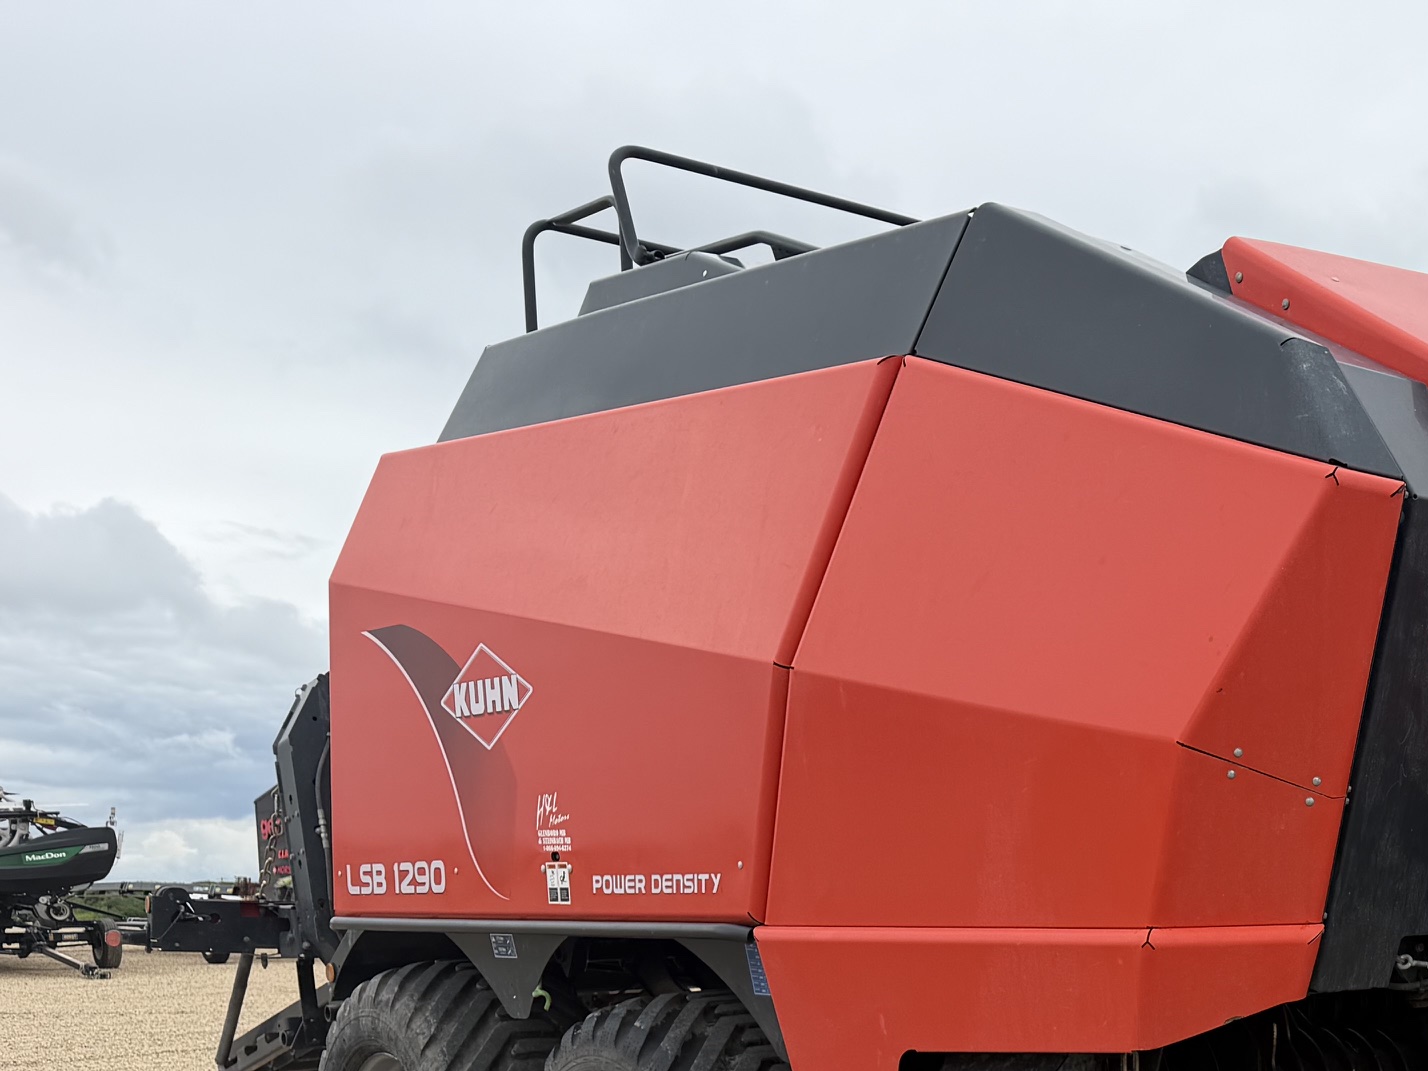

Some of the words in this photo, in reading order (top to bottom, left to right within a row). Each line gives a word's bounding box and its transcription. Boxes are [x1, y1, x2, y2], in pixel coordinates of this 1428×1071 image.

[453, 673, 520, 718] KUHN
[25, 851, 67, 862] MacDon
[346, 863, 387, 895] LSB
[393, 859, 446, 895] 1290
[592, 874, 646, 895] POWER
[651, 872, 721, 894] DENSITY
